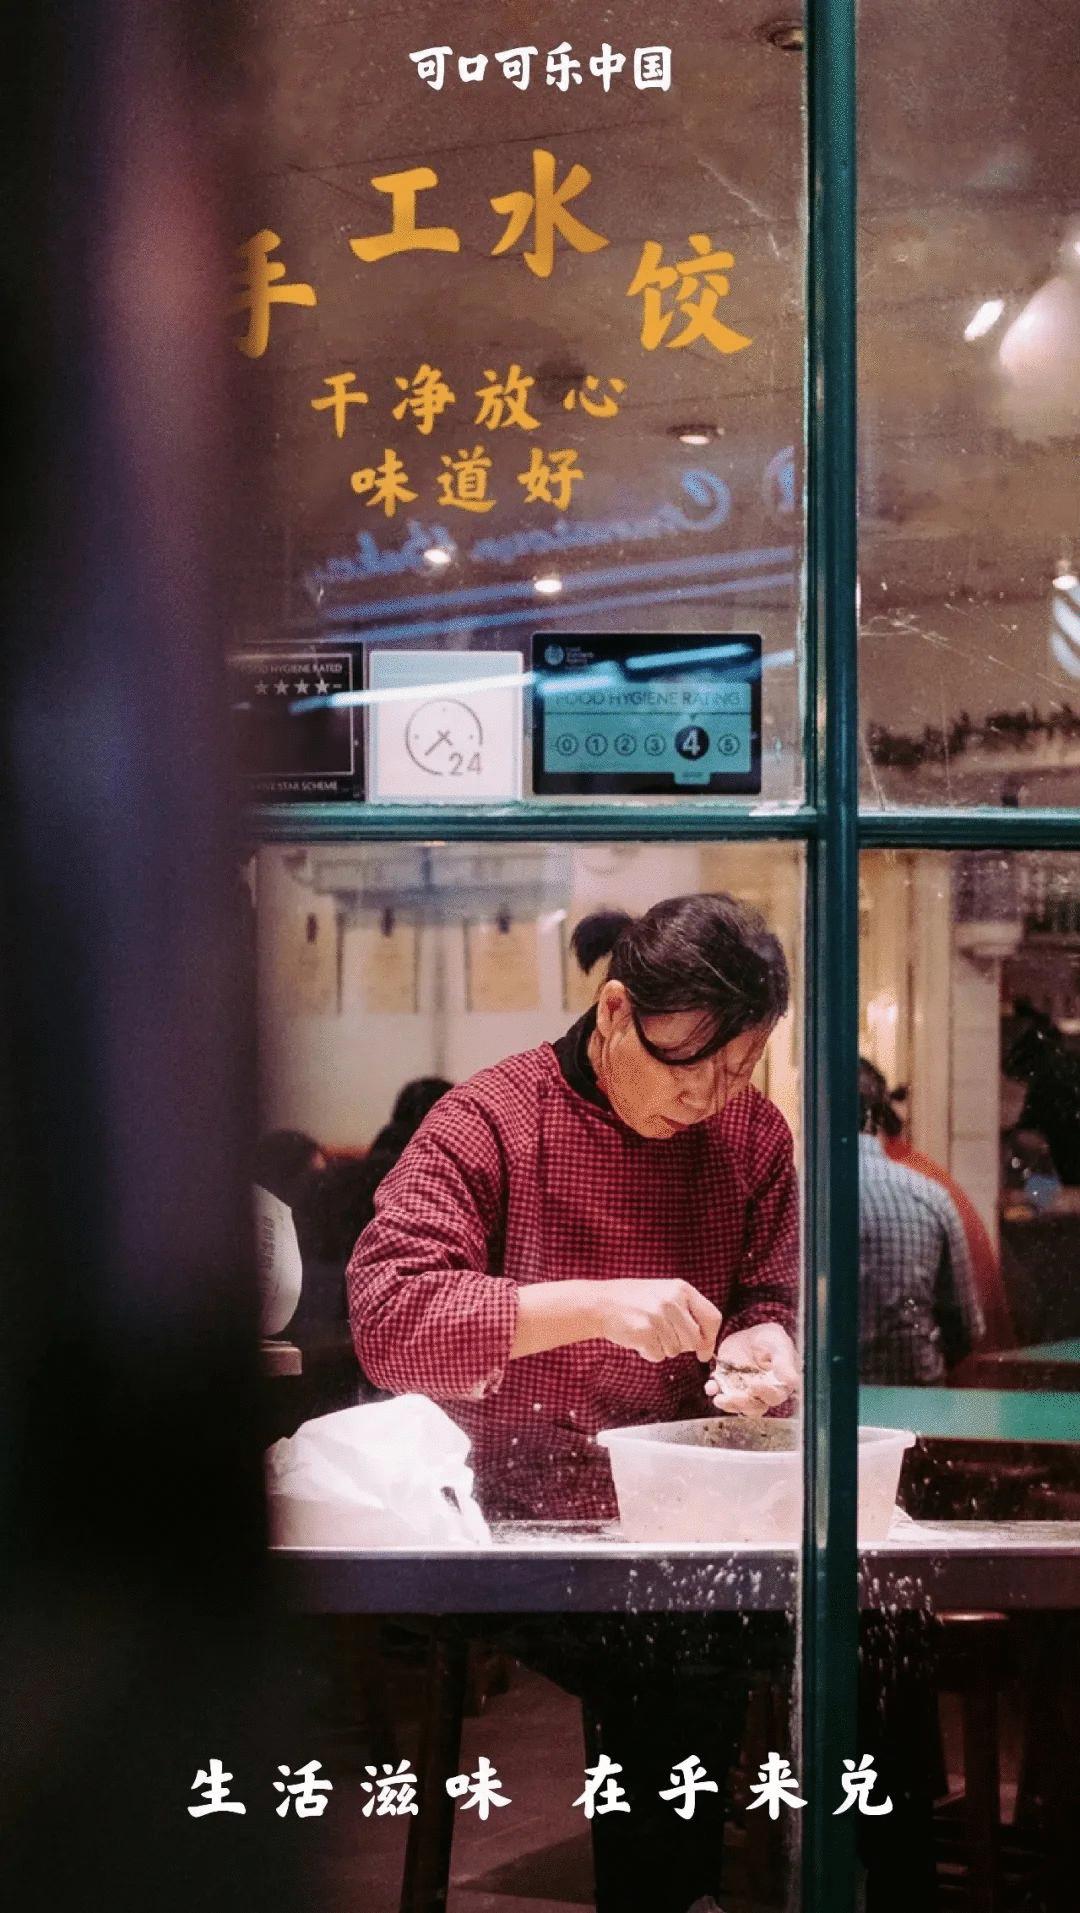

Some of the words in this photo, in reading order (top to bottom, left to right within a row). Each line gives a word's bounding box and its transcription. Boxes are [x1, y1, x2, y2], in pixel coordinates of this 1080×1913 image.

[235, 148, 752, 358] 手工水饺
[311, 363, 627, 439] 干净放心
[352, 446, 584, 517] 味道好
[609, 690, 679, 705] HYGIENE
[449, 752, 482, 775] 24
[682, 729, 701, 756] 4
